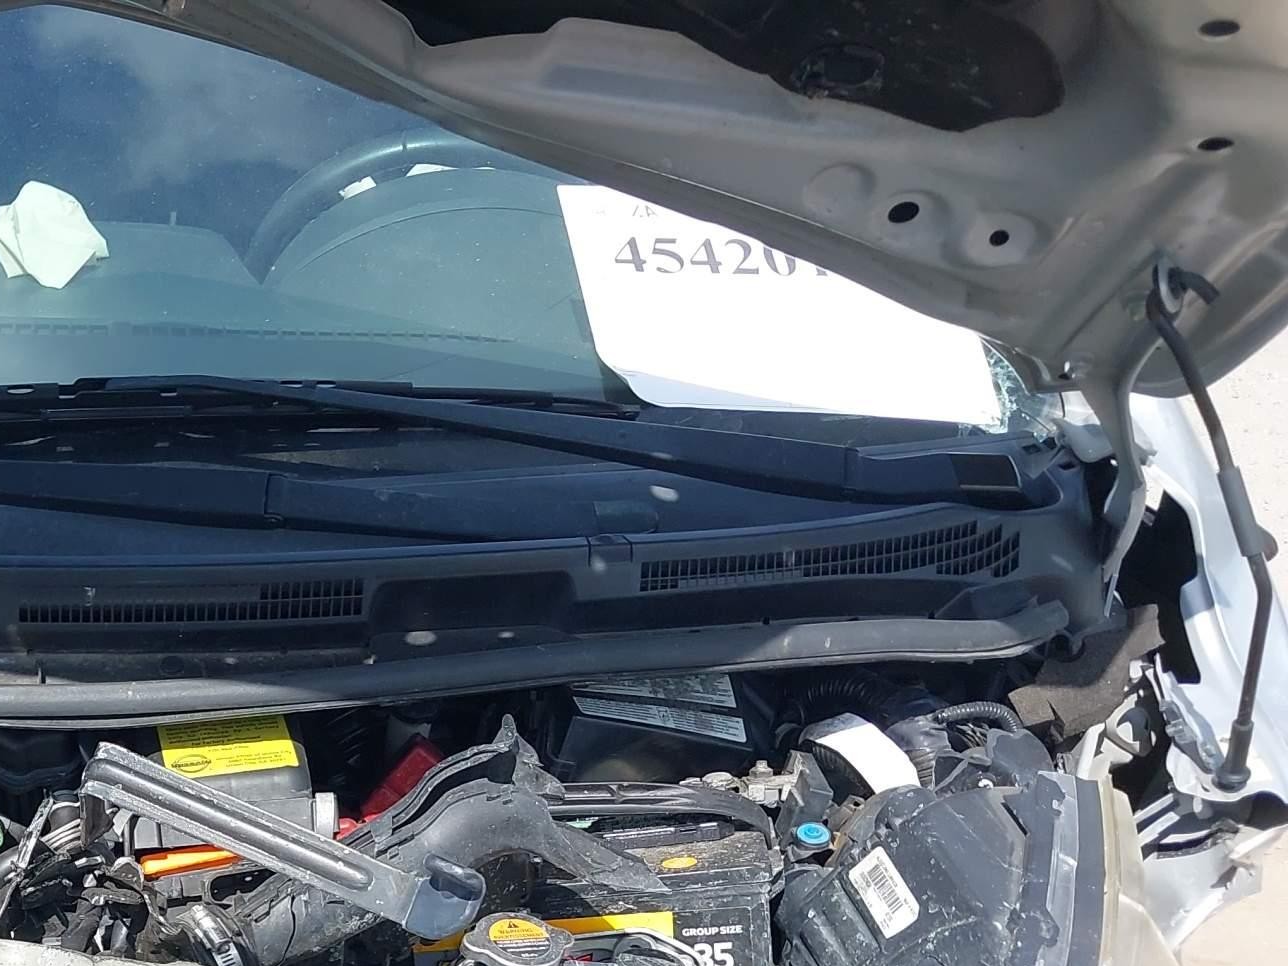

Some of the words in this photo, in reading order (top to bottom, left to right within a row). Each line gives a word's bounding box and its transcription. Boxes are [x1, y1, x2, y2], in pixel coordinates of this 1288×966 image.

[614, 236, 828, 277] 45420
[682, 926, 719, 936] GROUP
[719, 924, 743, 935] SIZE
